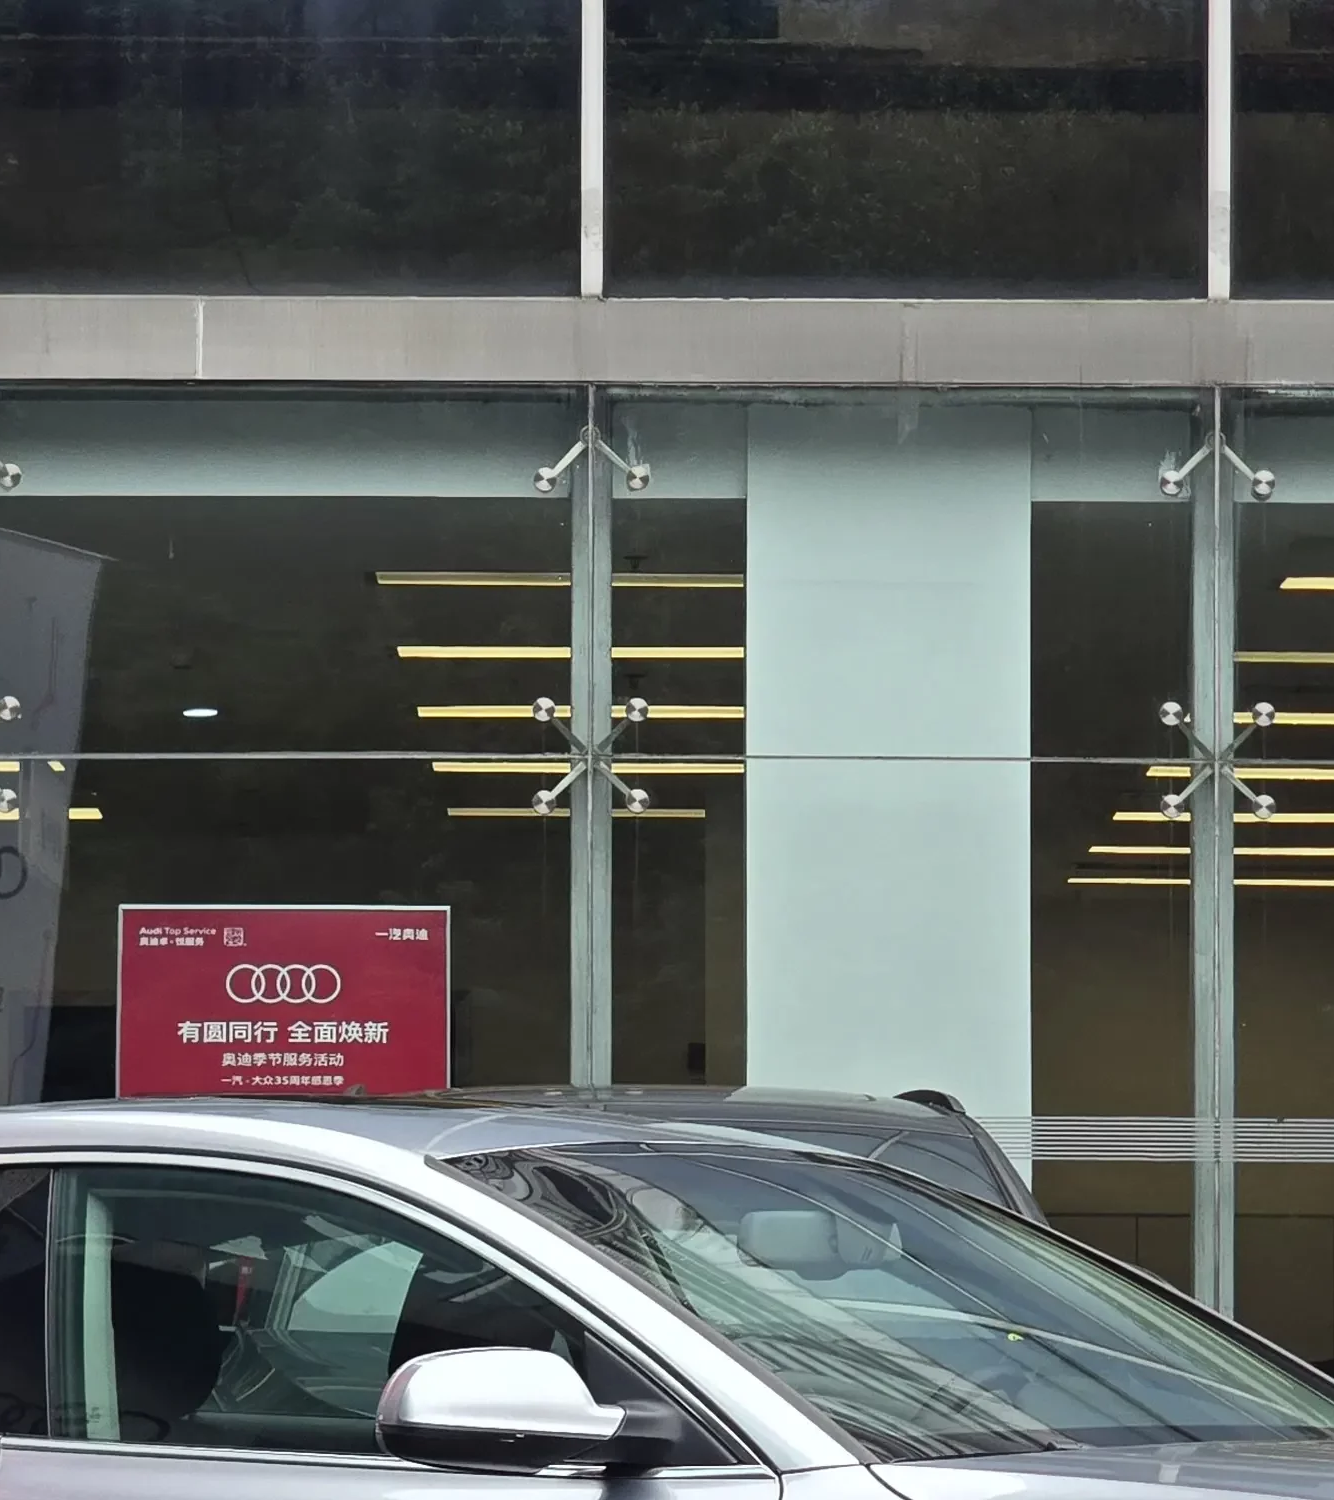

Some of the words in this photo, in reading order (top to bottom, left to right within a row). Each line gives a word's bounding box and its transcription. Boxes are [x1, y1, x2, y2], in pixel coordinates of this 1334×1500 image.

[139, 927, 163, 936] Audi
[164, 927, 182, 936] Top
[183, 927, 217, 936] Service
[177, 1020, 279, 1044] 有圆同行
[287, 1020, 390, 1044] 全面焕新
[221, 1052, 345, 1067] 奥迪季节服务活动
